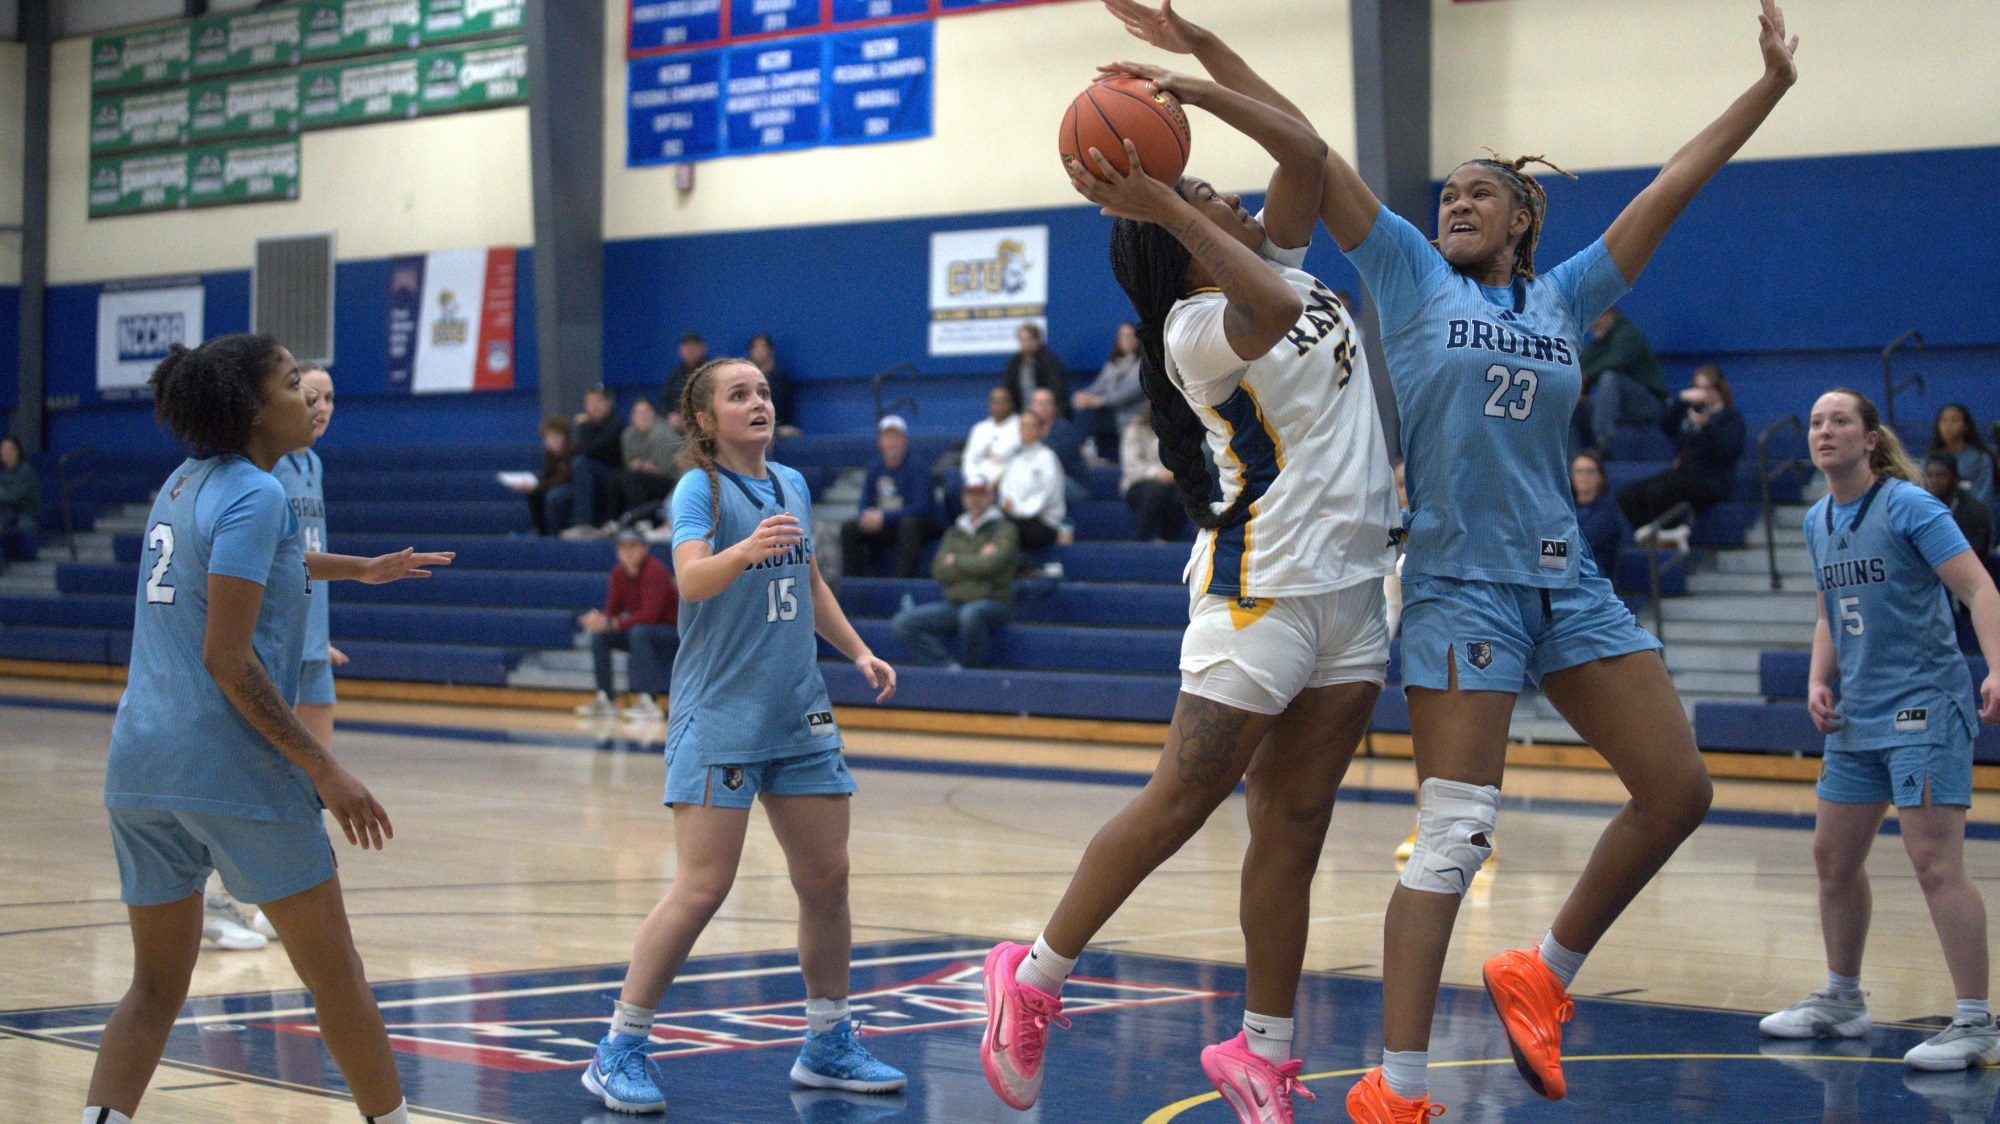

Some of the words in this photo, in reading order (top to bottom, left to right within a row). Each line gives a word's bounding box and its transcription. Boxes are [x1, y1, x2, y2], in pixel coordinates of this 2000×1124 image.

[947, 259, 1003, 296] CIU
[1446, 319, 1573, 367] BRUINS
[1483, 363, 1539, 422] 23
[146, 521, 176, 606] 2
[745, 537, 812, 571] UINS
[766, 576, 798, 623] 15
[1839, 596, 1865, 637] 5
